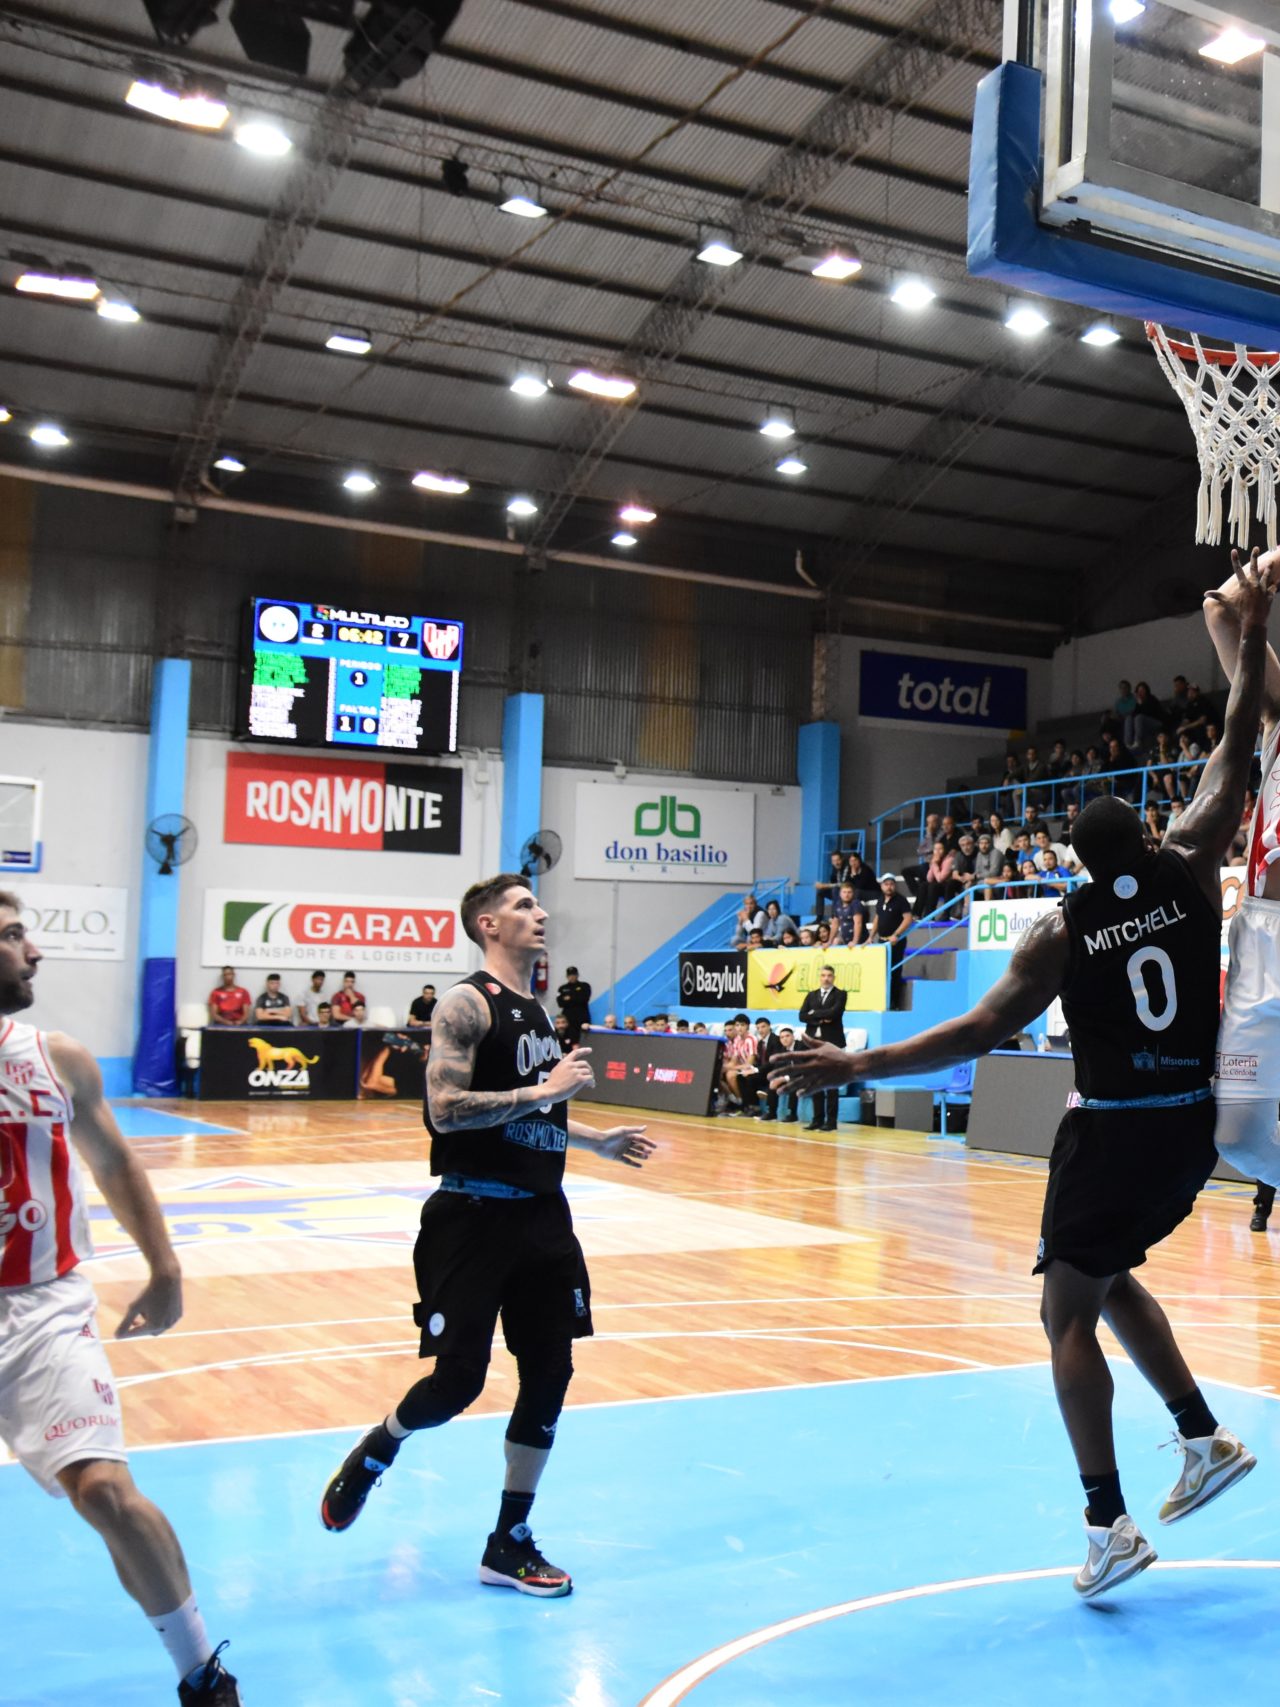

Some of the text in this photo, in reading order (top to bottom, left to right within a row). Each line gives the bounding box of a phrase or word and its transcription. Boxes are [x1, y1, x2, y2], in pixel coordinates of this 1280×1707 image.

[311, 624, 325, 638] 2
[398, 632, 410, 647] 7
[354, 672, 364, 686] 1
[898, 673, 992, 717] total
[340, 716, 351, 732] 1
[246, 777, 443, 834] ROSAMONTE
[605, 840, 728, 864] don basilio
[303, 911, 450, 943] GARAY
[1083, 900, 1187, 956] MITCHELL
[224, 945, 338, 961] TRANSPORTE
[345, 949, 354, 960] &
[696, 964, 745, 1000] Bazyluk
[1126, 945, 1178, 1032] 0
[1160, 1056, 1200, 1067] Misiones
[248, 1069, 310, 1087] ONZA
[44, 1414, 118, 1441] QUORUM
